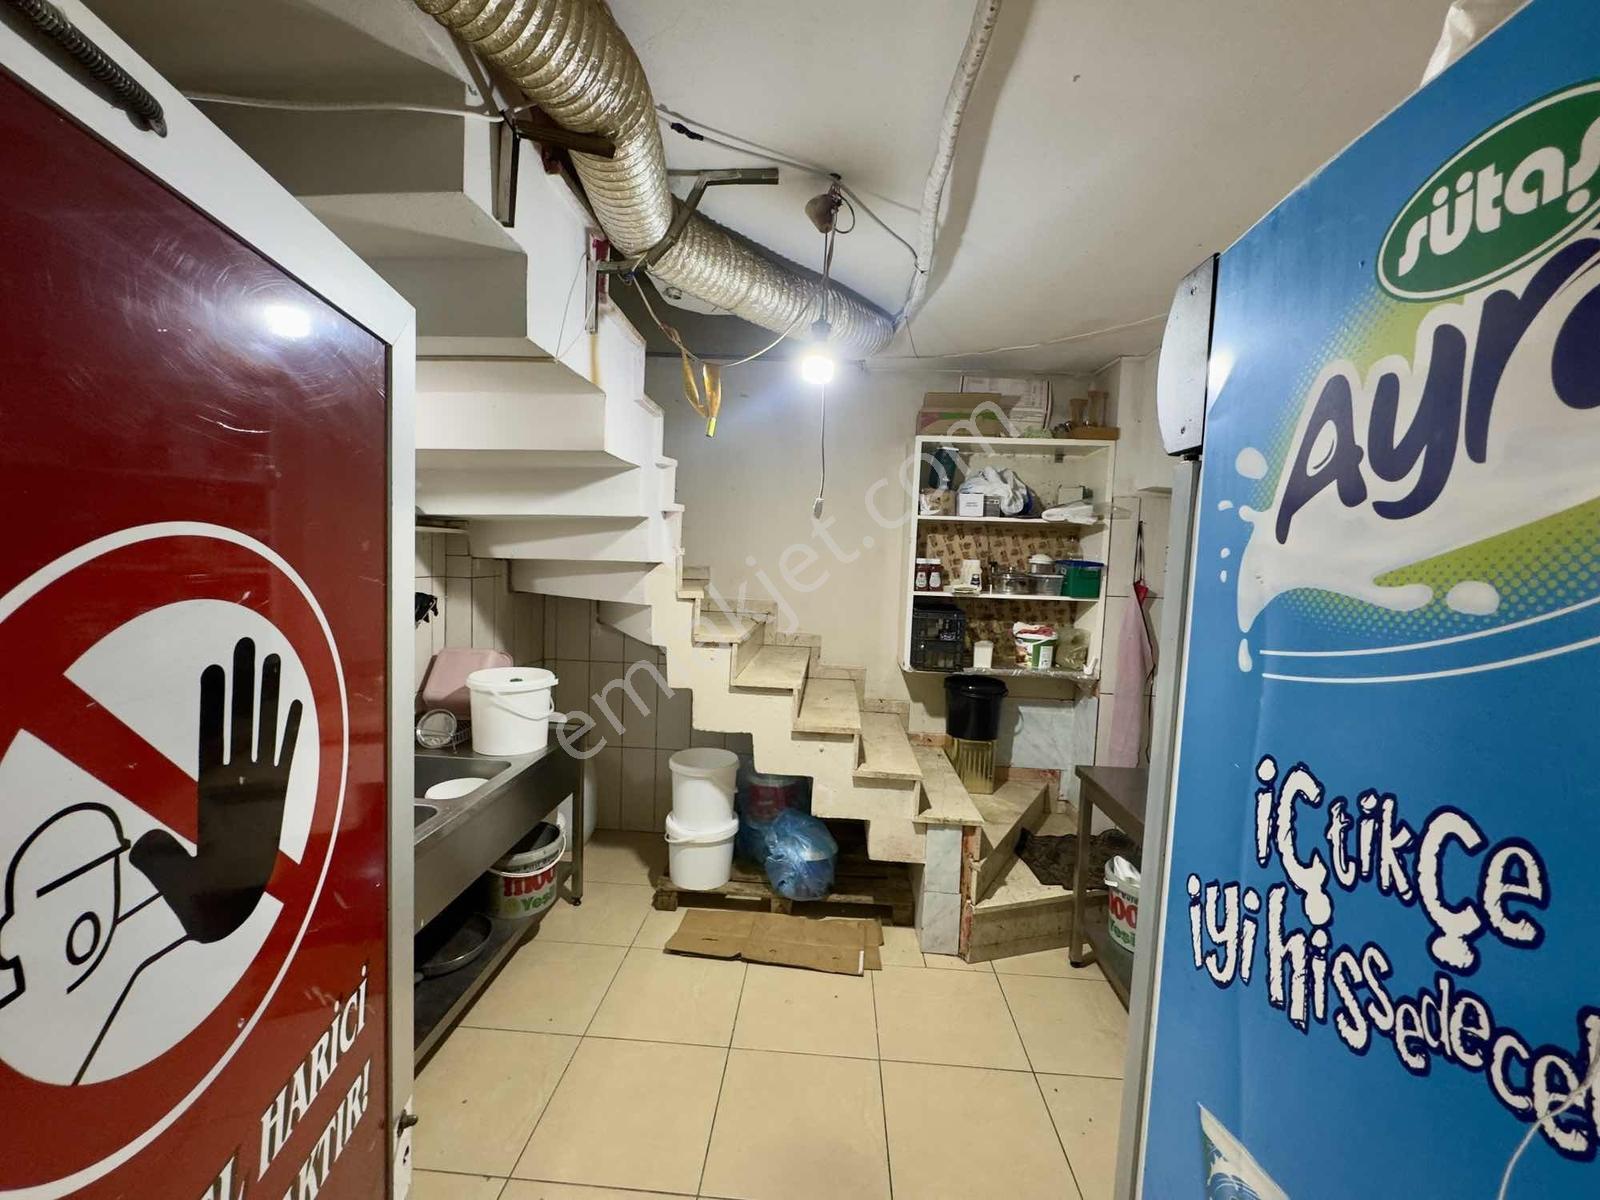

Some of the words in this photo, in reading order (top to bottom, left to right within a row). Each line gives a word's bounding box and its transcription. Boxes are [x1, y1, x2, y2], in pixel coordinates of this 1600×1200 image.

[1188, 873, 1262, 988] iyi
[257, 965, 368, 1183] HARİCİ
[283, 1058, 371, 1200] KTIR!
